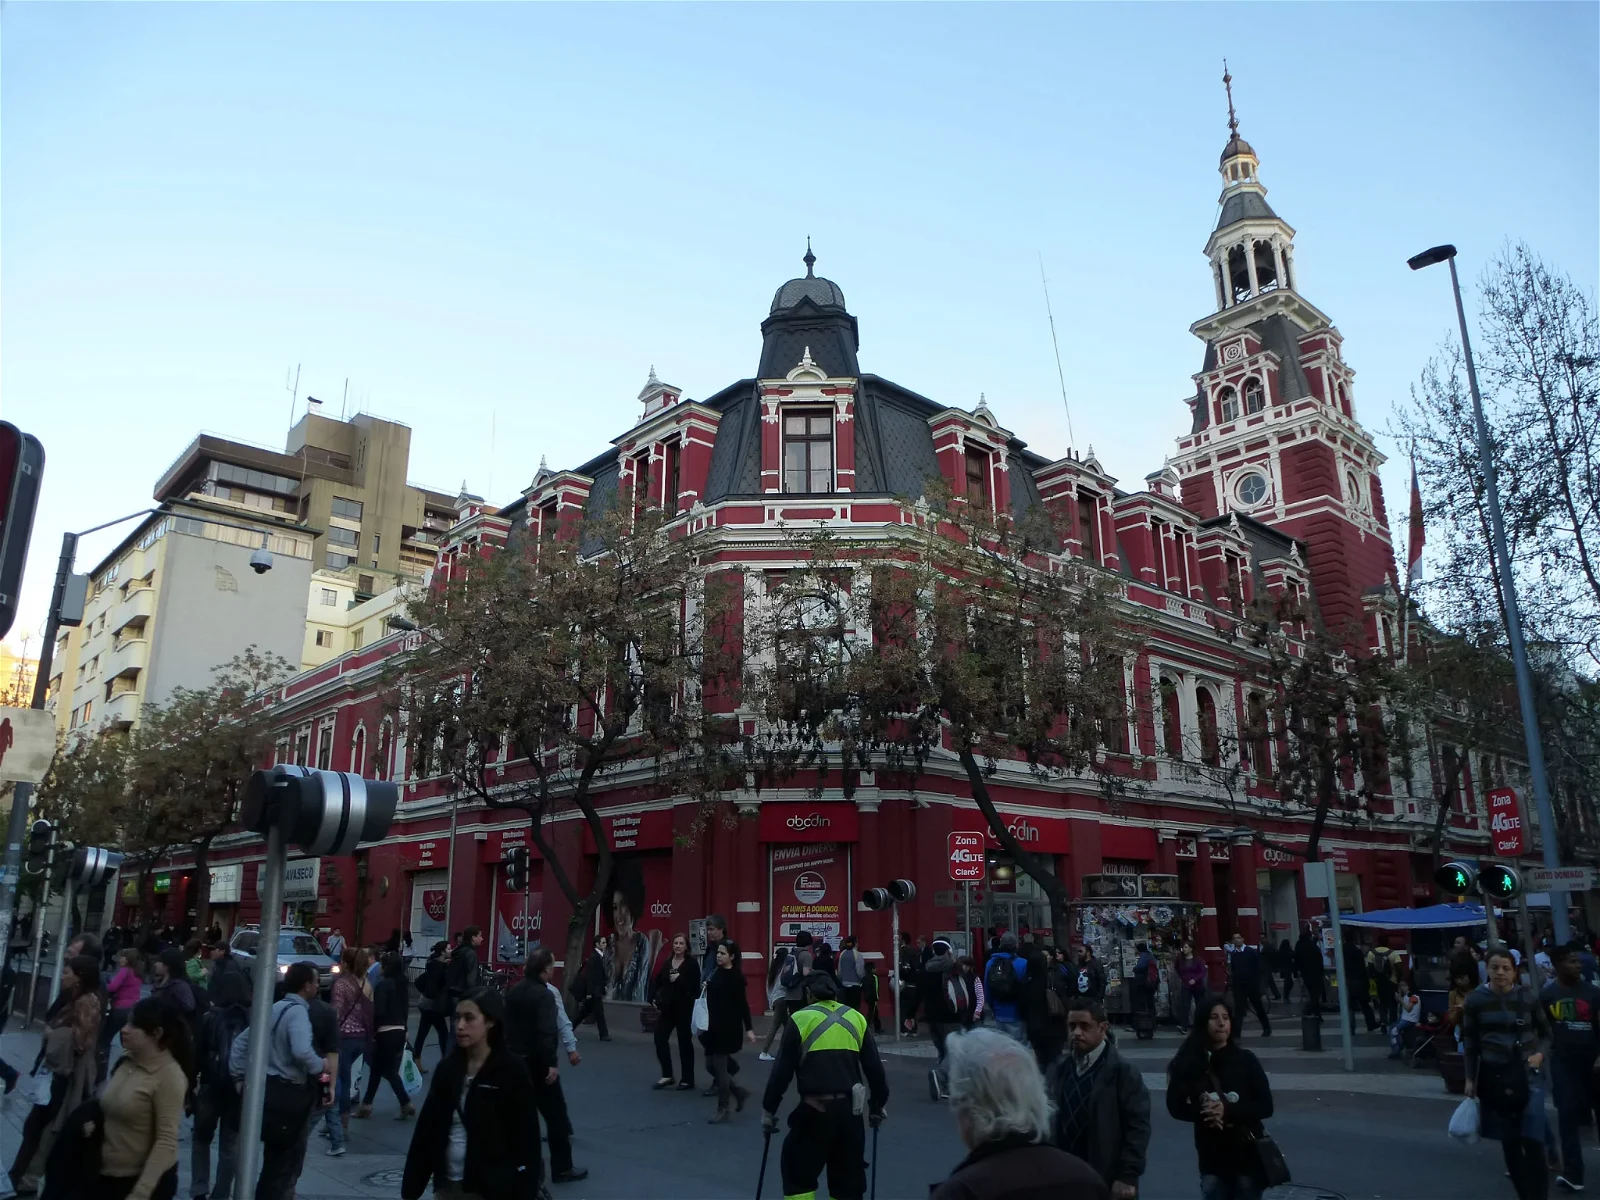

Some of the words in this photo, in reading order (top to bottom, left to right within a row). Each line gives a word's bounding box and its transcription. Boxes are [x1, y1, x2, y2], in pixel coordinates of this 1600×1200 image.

[1492, 794, 1511, 807] Zona
[786, 814, 830, 828] abcdin
[955, 836, 977, 845] Zona
[1498, 840, 1516, 850] Claro
[286, 867, 314, 881] AVASECO
[955, 868, 976, 876] Claro
[1534, 872, 1553, 880] SANTO
[1554, 870, 1584, 879] DOMINGO
